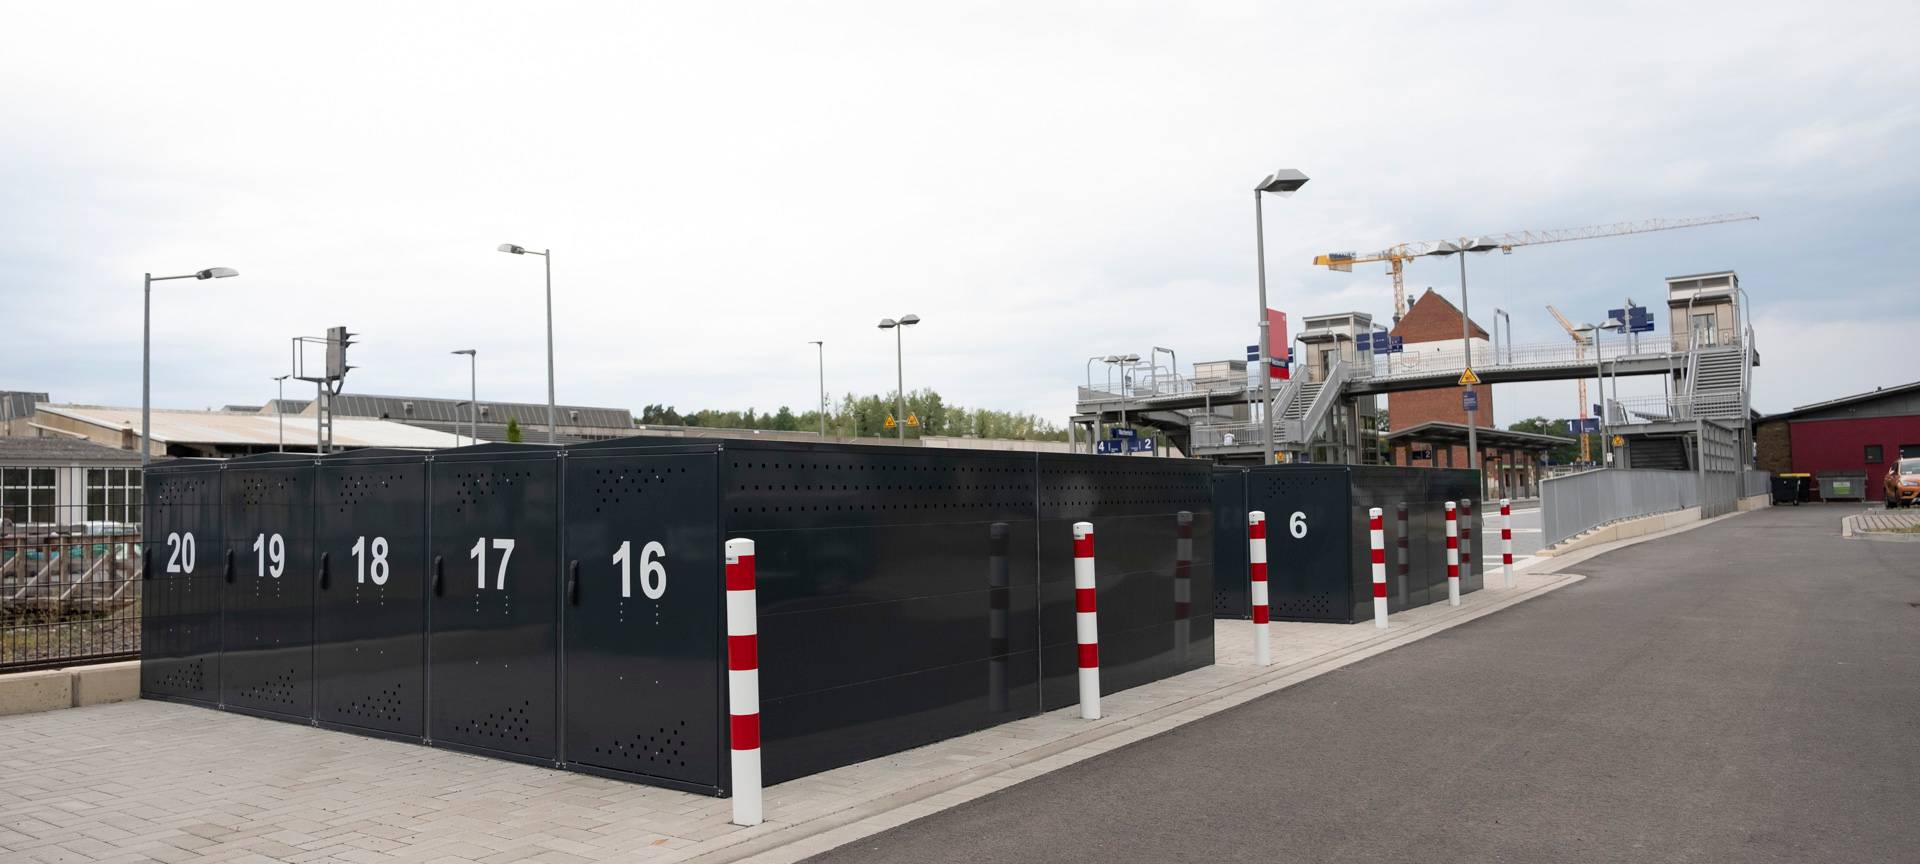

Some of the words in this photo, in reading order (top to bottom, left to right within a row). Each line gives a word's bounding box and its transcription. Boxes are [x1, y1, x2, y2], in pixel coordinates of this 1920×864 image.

[1144, 438, 1151, 449] 2
[1567, 420, 1573, 432] 1
[1098, 441, 1105, 452] 4
[1425, 450, 1431, 458] 2
[1289, 511, 1308, 539] 6
[166, 531, 196, 574] 20
[253, 533, 286, 578] 19
[351, 535, 390, 586] 18
[470, 537, 516, 590] 17
[612, 540, 668, 600] 16
